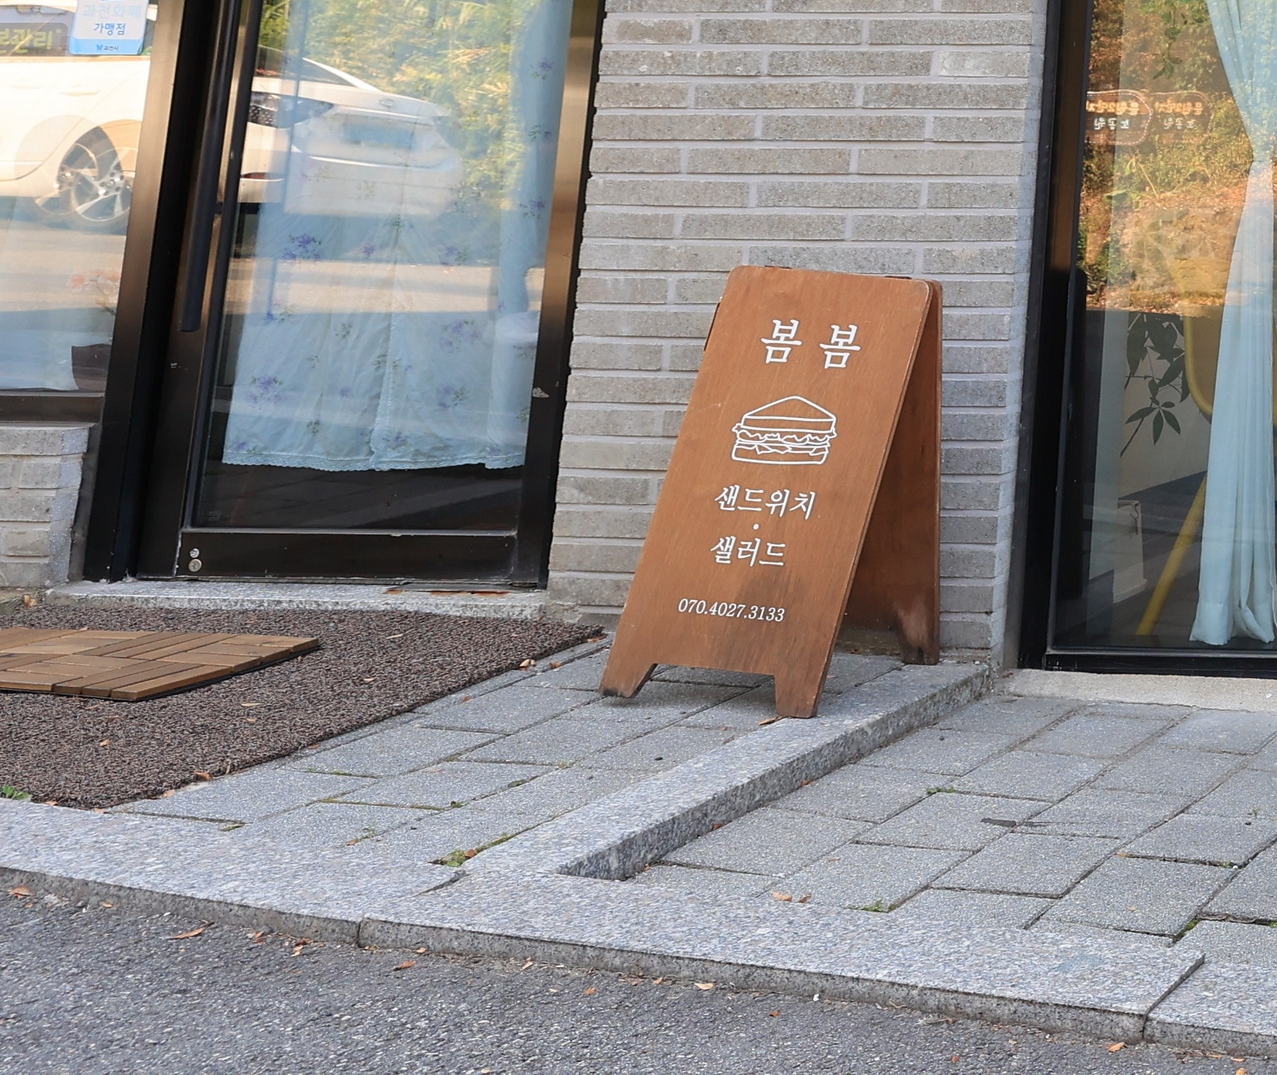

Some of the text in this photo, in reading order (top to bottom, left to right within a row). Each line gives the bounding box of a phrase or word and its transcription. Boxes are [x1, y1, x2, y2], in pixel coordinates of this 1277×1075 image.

[94, 22, 126, 36] 가맹점
[714, 484, 816, 520] 샌드위치
[710, 536, 787, 567] 샐러드
[678, 598, 786, 623] 070.4027.3133
